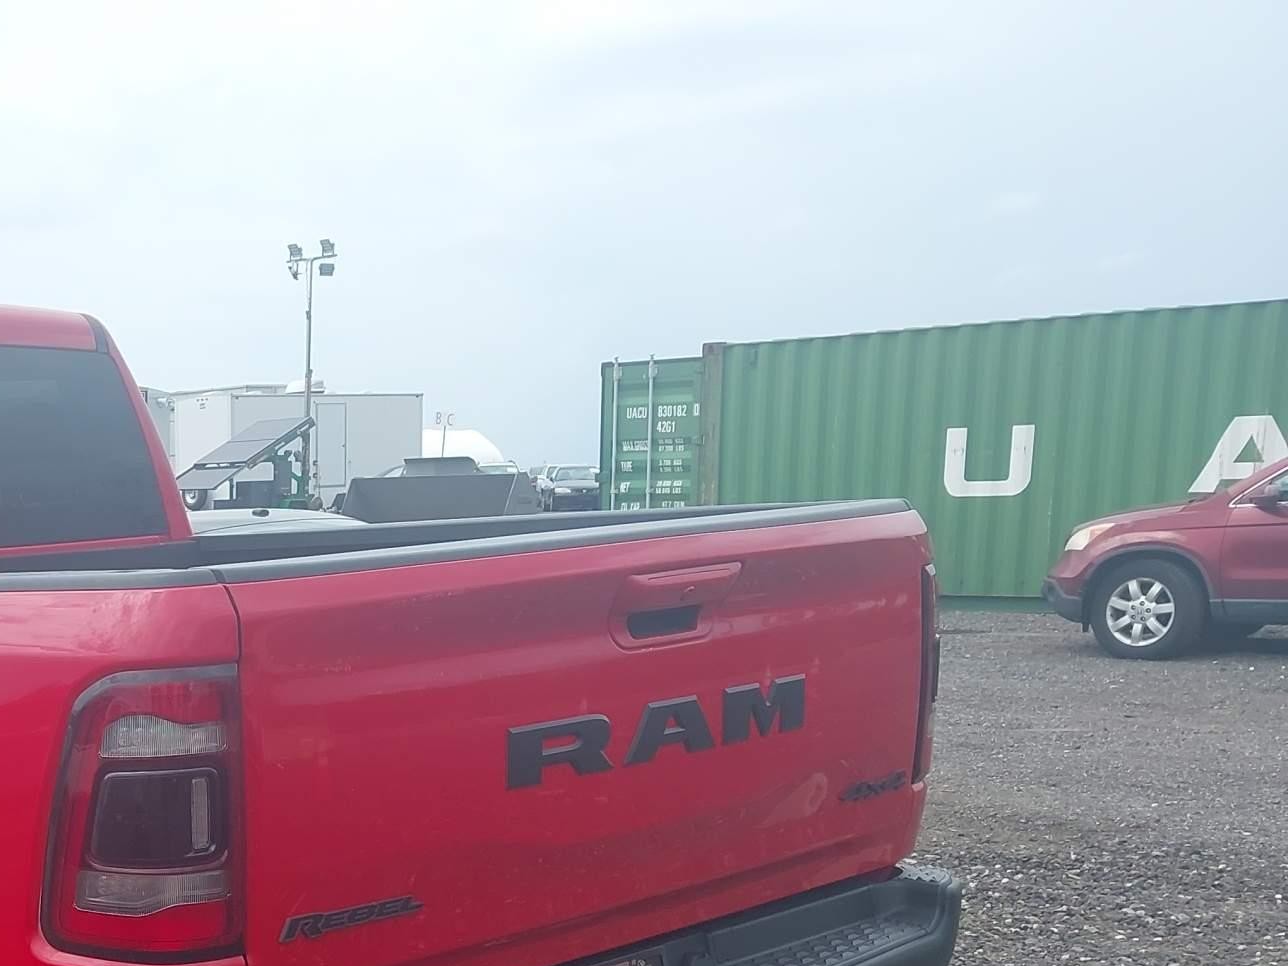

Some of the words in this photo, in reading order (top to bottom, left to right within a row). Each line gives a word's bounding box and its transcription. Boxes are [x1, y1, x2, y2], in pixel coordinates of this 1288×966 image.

[626, 406, 648, 419] UACU
[657, 404, 687, 418] 830182
[656, 420, 677, 433] 42G1
[505, 672, 807, 790] RAM
